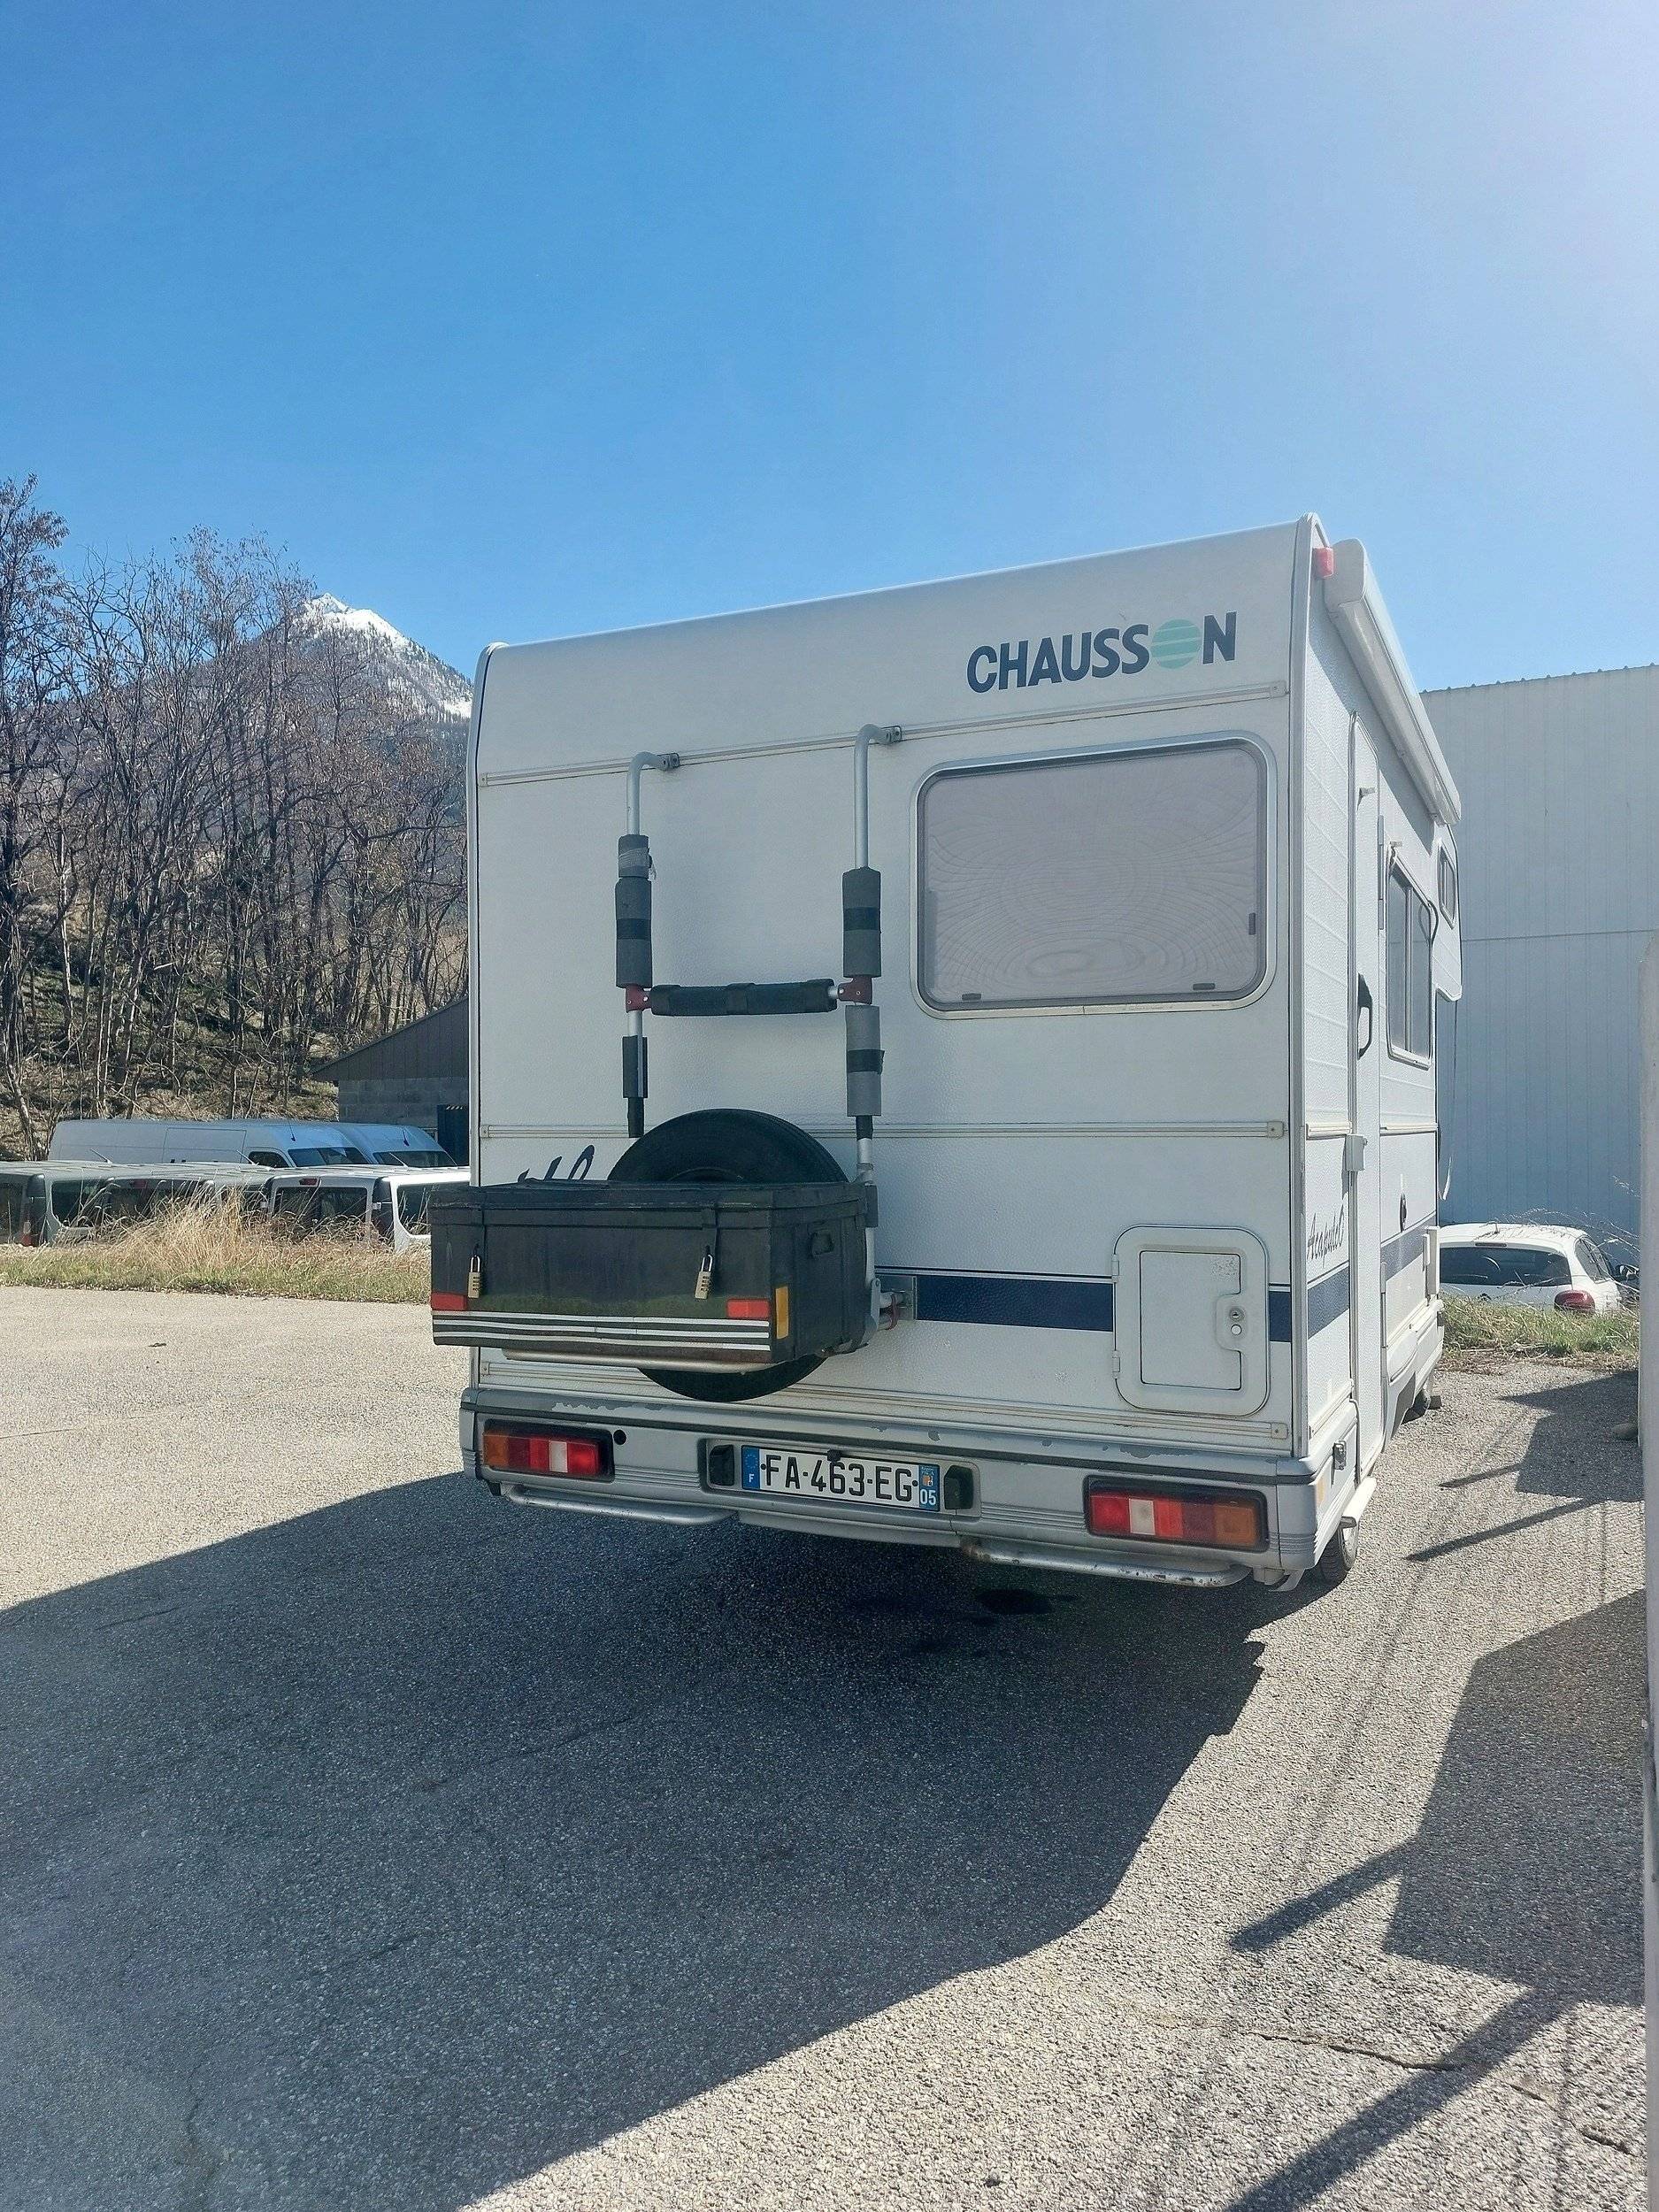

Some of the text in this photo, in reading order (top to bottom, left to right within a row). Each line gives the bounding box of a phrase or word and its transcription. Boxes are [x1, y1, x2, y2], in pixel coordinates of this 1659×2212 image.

[966, 611, 1238, 694] CHAUSSON
[749, 1473, 755, 1484] F
[764, 1454, 913, 1502] FA-463-EG
[919, 1488, 937, 1506] 05
